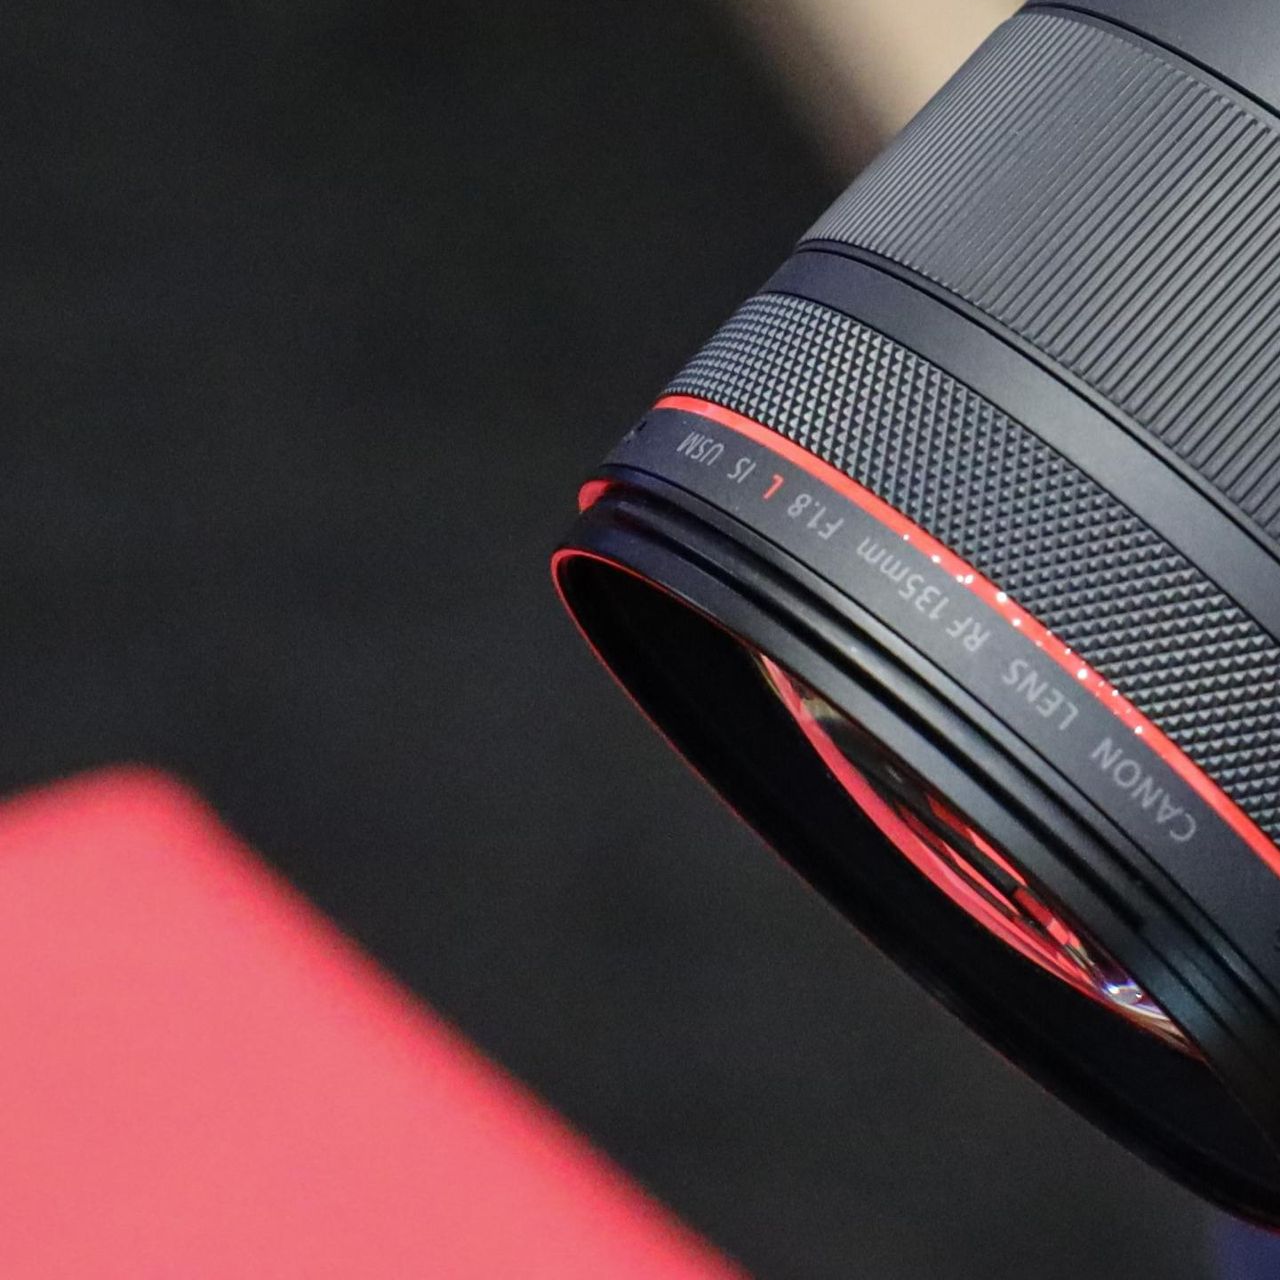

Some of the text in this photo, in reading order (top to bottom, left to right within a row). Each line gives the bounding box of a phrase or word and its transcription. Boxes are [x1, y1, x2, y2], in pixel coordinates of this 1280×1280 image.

[676, 431, 1196, 842] CANON LENS RF 135mm F1.8 L IS USM
